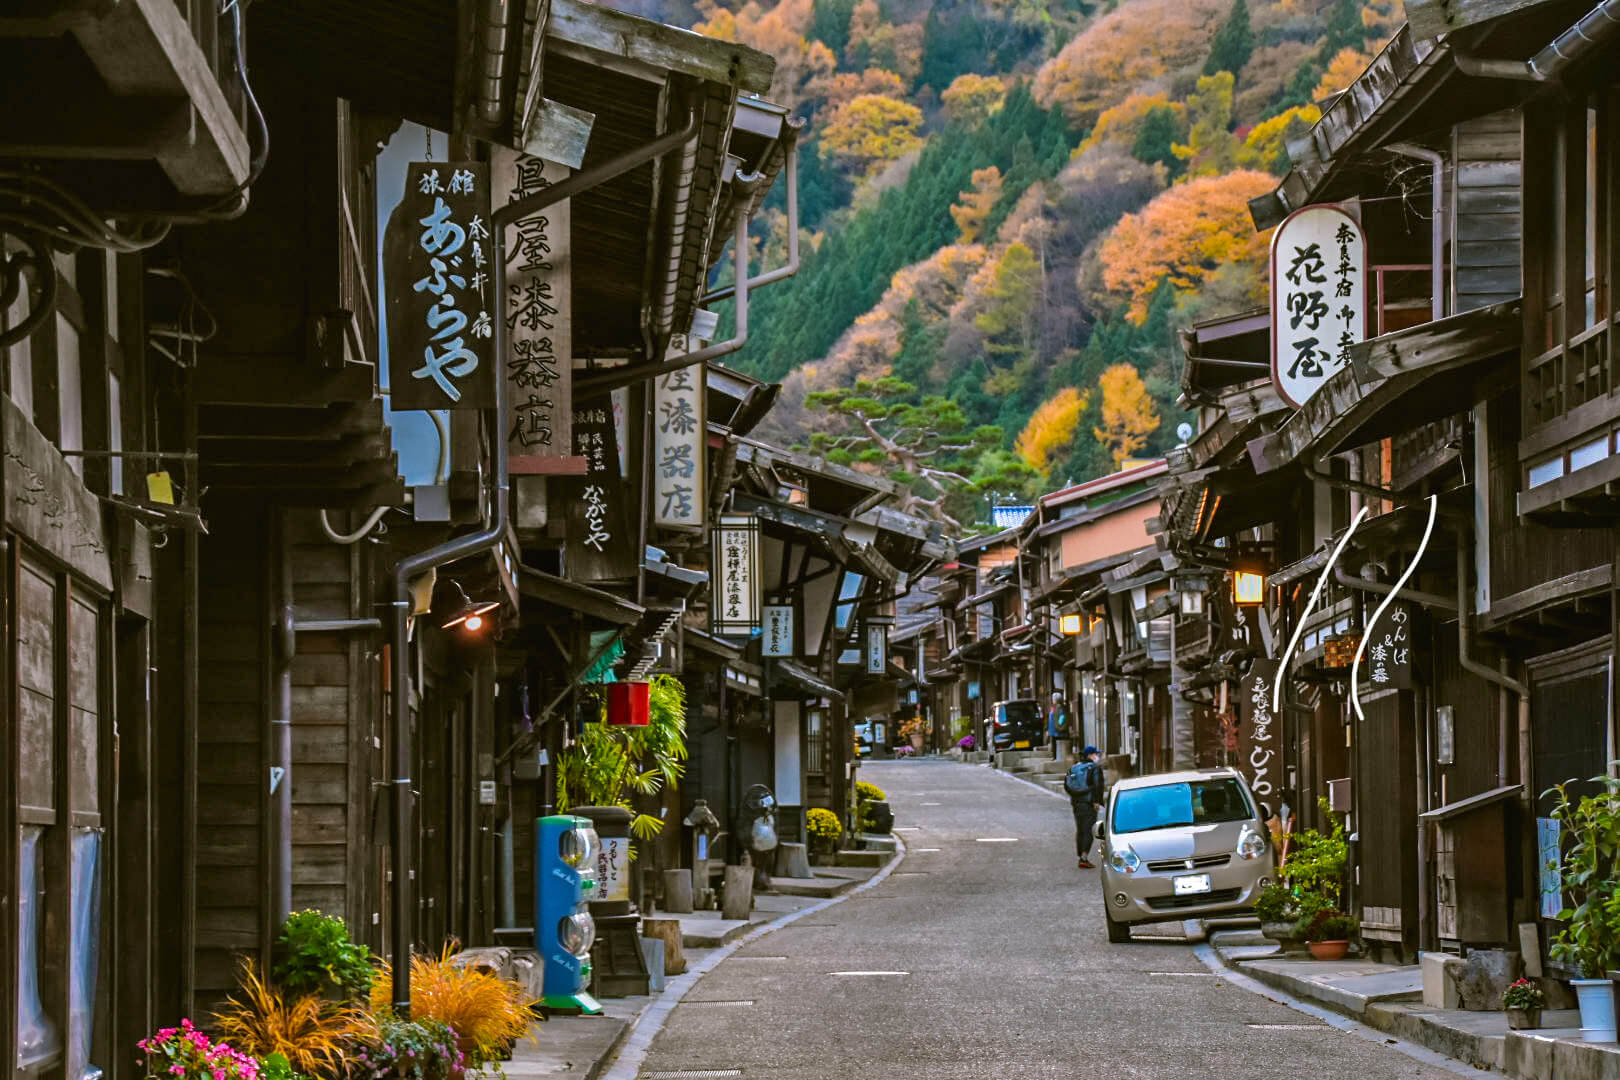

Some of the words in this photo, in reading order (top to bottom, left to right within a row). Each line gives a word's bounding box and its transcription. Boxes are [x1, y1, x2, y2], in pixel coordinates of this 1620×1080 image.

[418, 169, 476, 197] 旅館
[467, 213, 493, 339] 奈良井宿
[1334, 222, 1357, 299] 奈良井宿
[411, 196, 479, 403] あぶらや
[1285, 242, 1332, 380] 花野屋
[582, 485, 611, 552] ながとや
[1371, 643, 1390, 683] 漆の器
[1384, 634, 1394, 647] &
[1391, 607, 1409, 665] めんば
